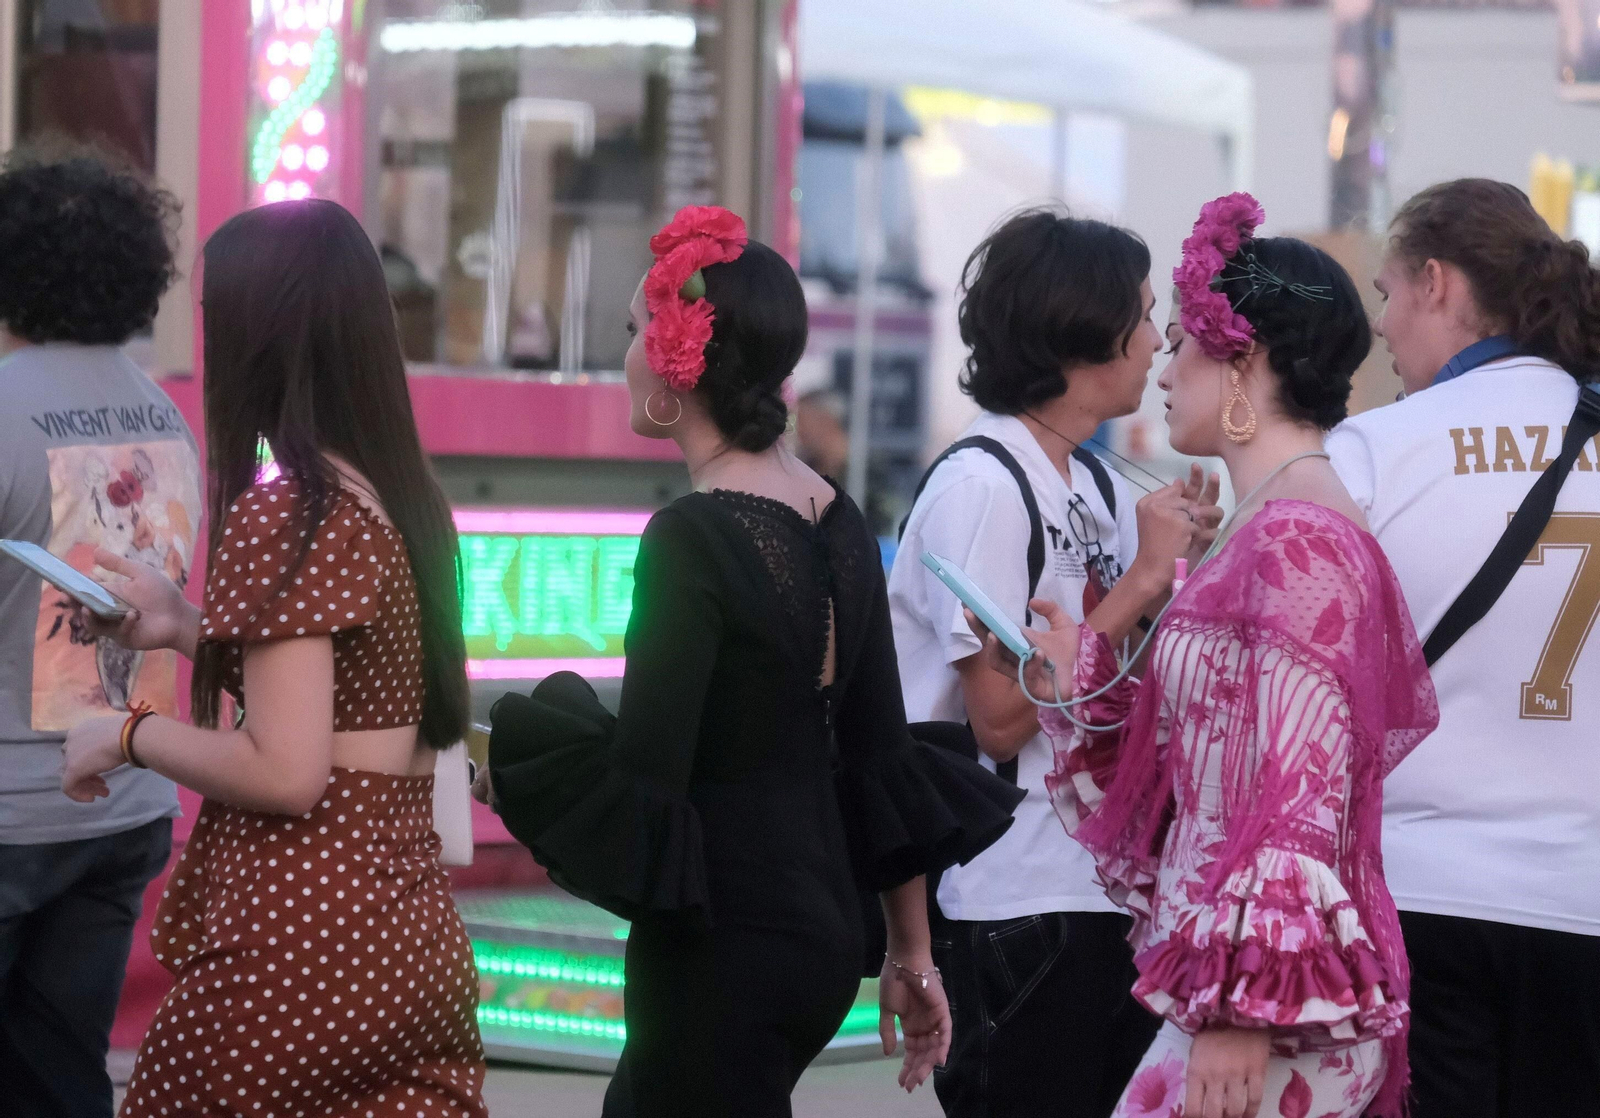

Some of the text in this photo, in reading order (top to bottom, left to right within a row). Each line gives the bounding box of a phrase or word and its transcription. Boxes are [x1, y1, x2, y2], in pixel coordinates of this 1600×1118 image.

[31, 407, 112, 439] VINCENT
[112, 404, 148, 434] VAN
[1449, 425, 1600, 475] HAZ
[1507, 511, 1600, 721] 7
[1535, 693, 1558, 711] RM
